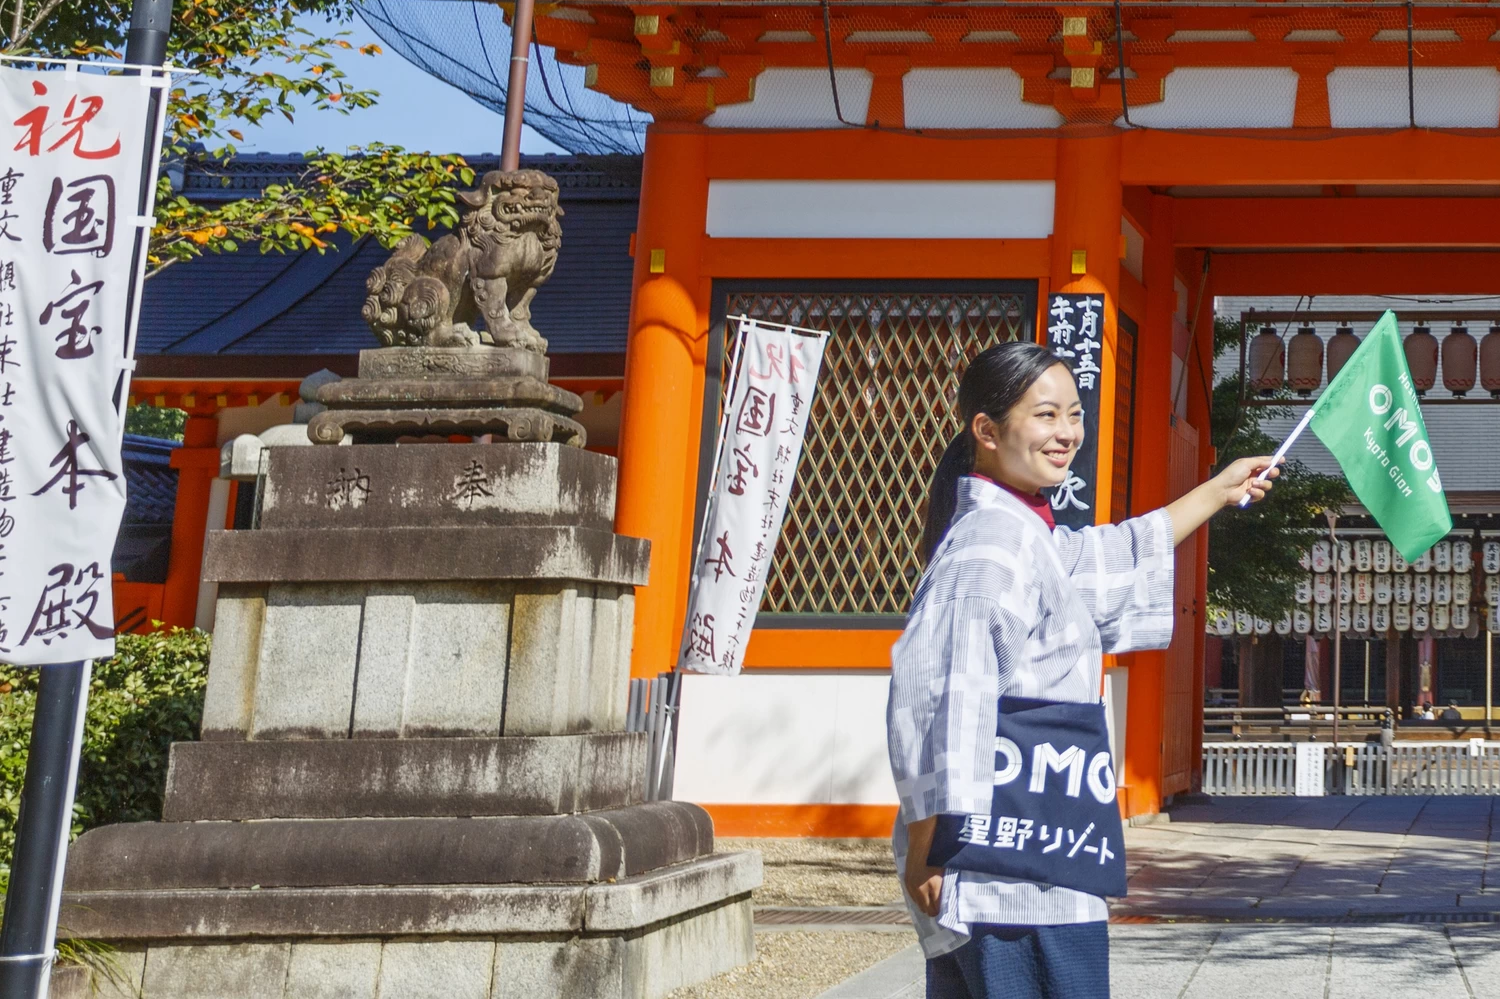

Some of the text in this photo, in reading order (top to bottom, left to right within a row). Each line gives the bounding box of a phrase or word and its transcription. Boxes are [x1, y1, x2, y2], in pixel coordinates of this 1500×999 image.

[1073, 296, 1102, 390] 十月十五日
[1364, 426, 1413, 497] Kyoto Gion
[993, 736, 1116, 804] OMO
[958, 814, 1115, 865] 星野リゾート
